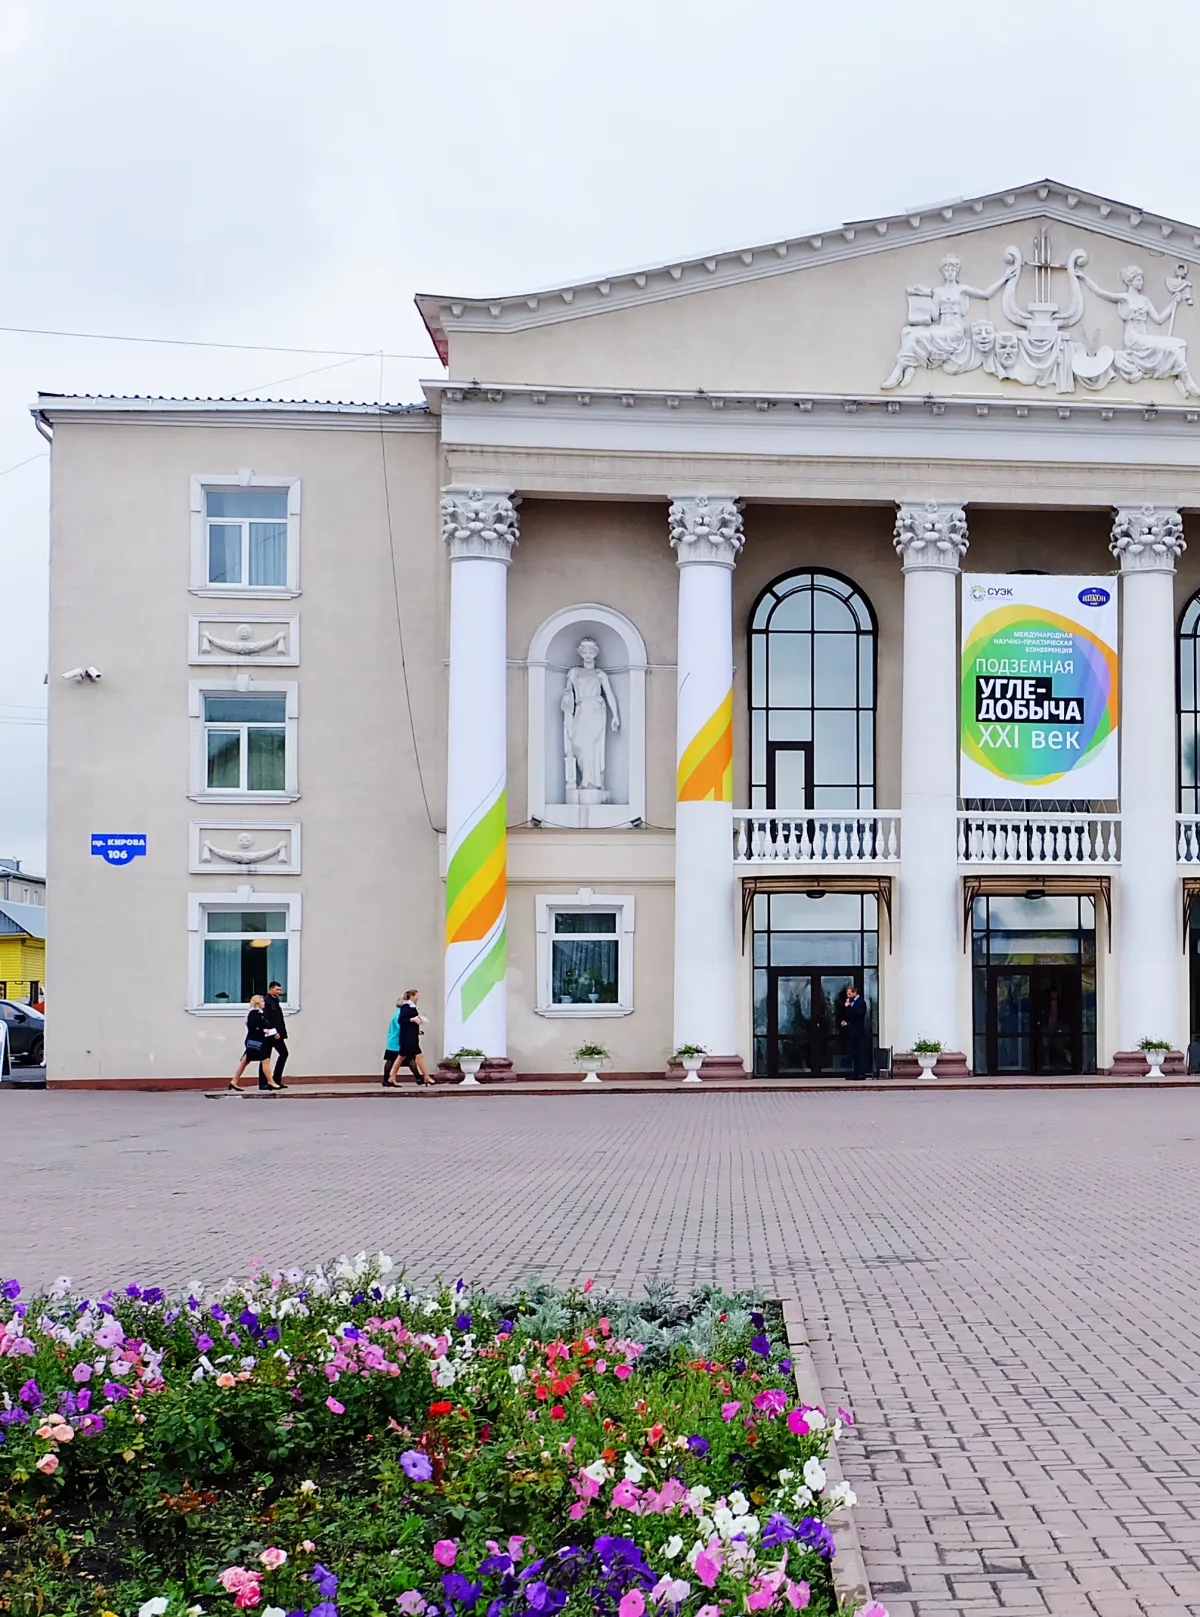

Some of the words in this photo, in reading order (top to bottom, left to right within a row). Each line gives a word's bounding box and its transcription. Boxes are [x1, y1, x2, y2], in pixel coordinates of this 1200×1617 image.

[987, 587, 1013, 596] СУЭК
[993, 638, 1073, 646] НАУЧНО-ПРАКТИЧЕСКАЯ
[1025, 646, 1073, 654] КОНФЕРЕНЦИЯ
[976, 658, 1074, 675] ПОДЗЕМНАЯ
[978, 678, 1047, 699] УГЛЕ-
[978, 699, 1082, 721] ДОБЫЧА
[978, 724, 1019, 749] XXI
[1031, 729, 1080, 750] век
[107, 850, 128, 859] 106
